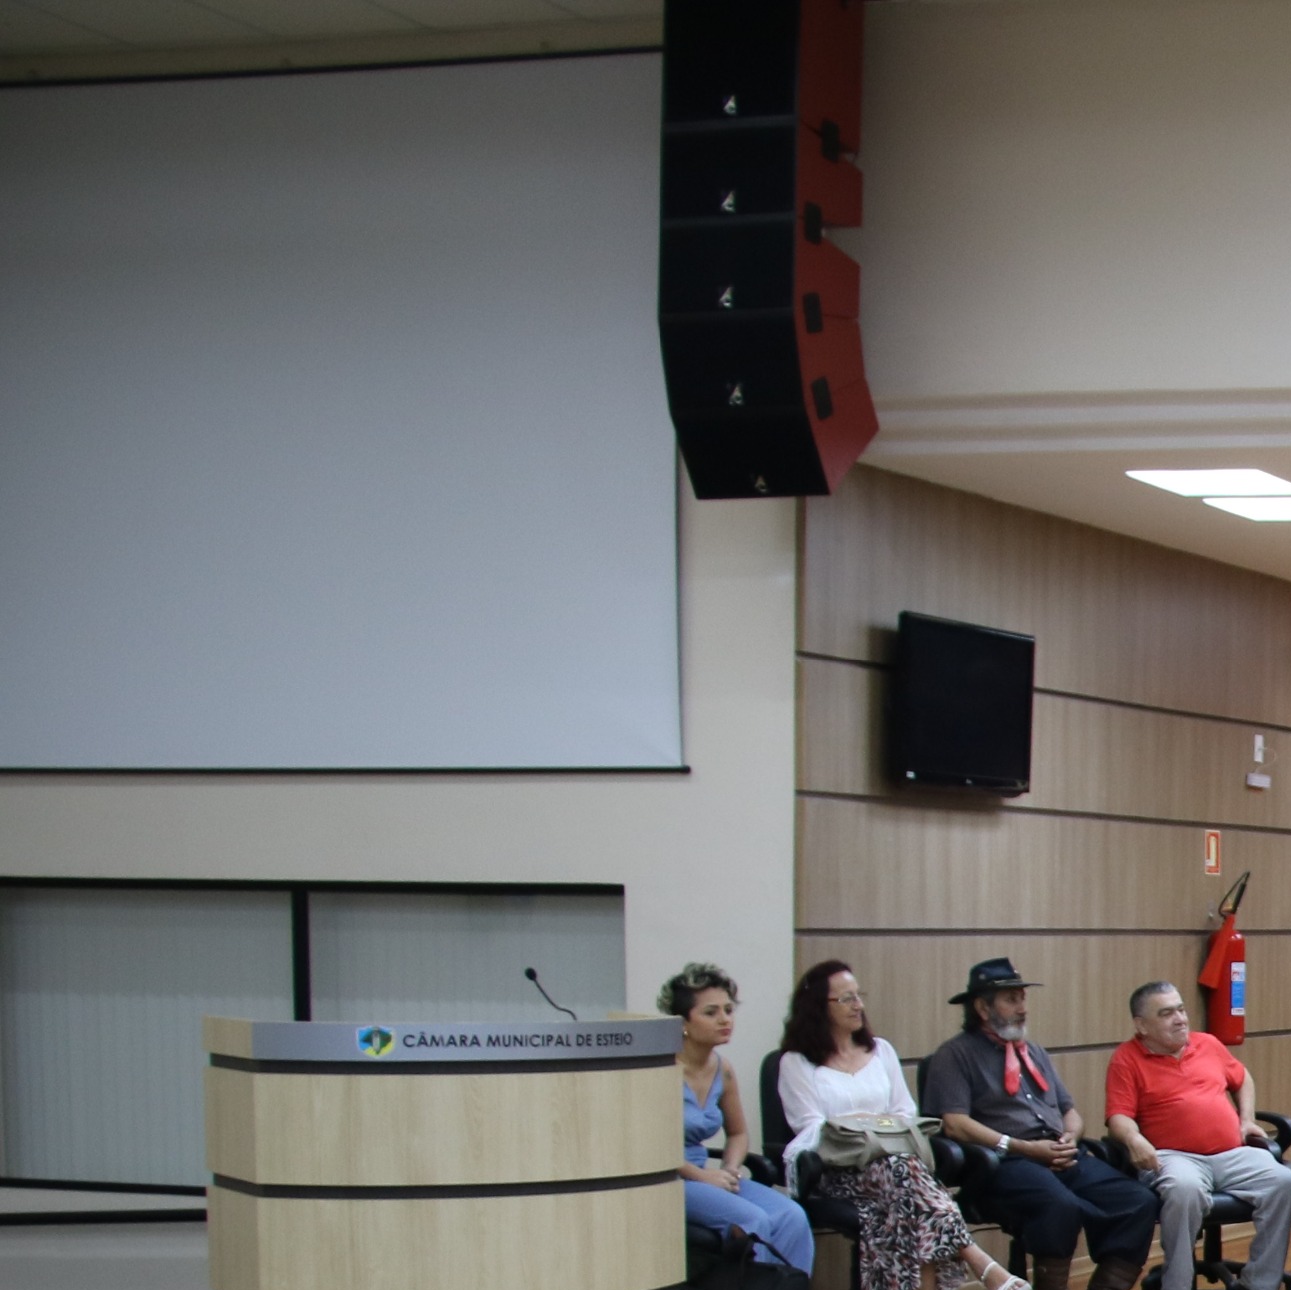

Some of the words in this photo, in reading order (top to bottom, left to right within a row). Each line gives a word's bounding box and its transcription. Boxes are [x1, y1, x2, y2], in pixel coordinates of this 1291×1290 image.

[402, 1031, 481, 1048] CÂMARA
[486, 1033, 572, 1048] MUNICIPAL
[575, 1033, 592, 1047] DE
[596, 1032, 633, 1047] ESTEIO
